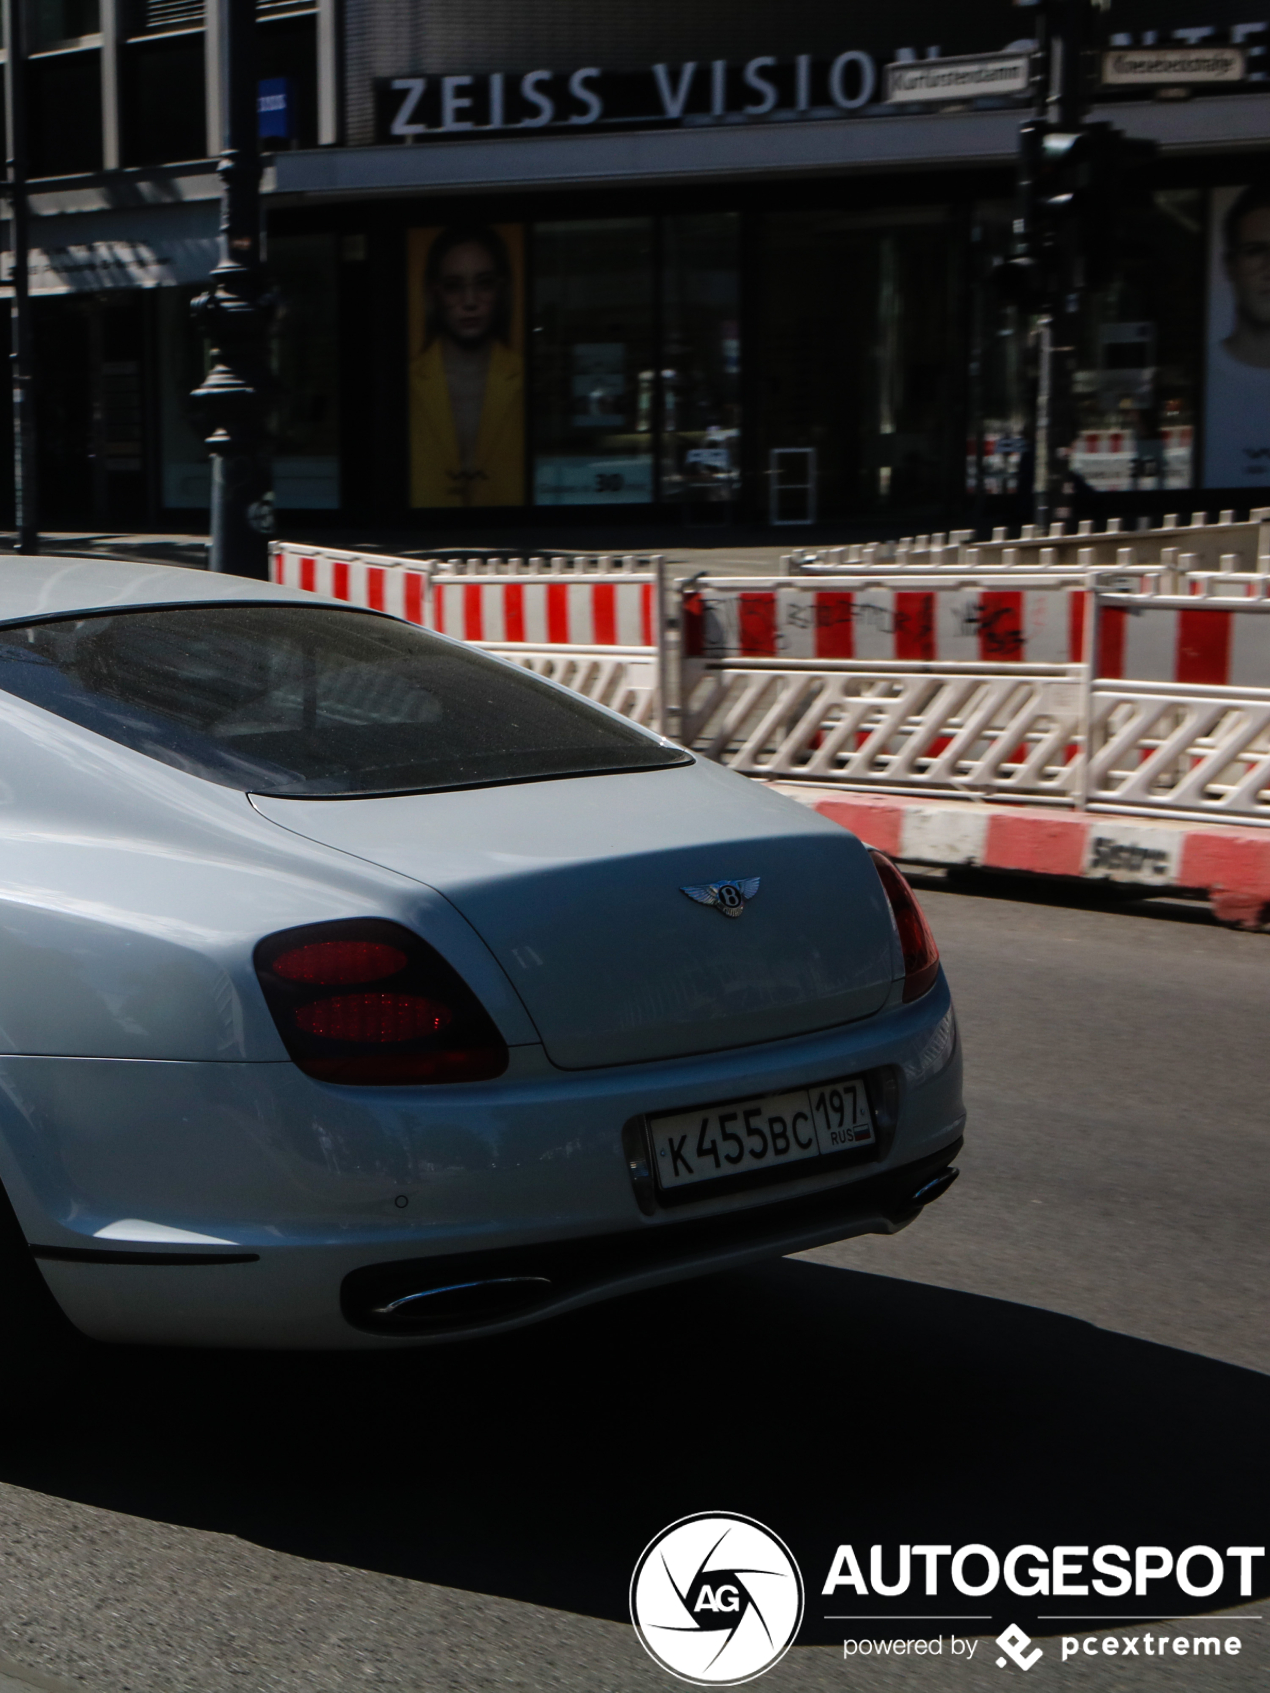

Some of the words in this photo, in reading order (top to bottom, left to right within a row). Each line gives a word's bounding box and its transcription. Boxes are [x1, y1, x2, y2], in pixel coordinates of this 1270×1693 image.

[389, 66, 603, 135] ZEISS
[651, 46, 941, 118] VISIO
[815, 1085, 858, 1130] 197
[831, 1128, 854, 1146] RUS
